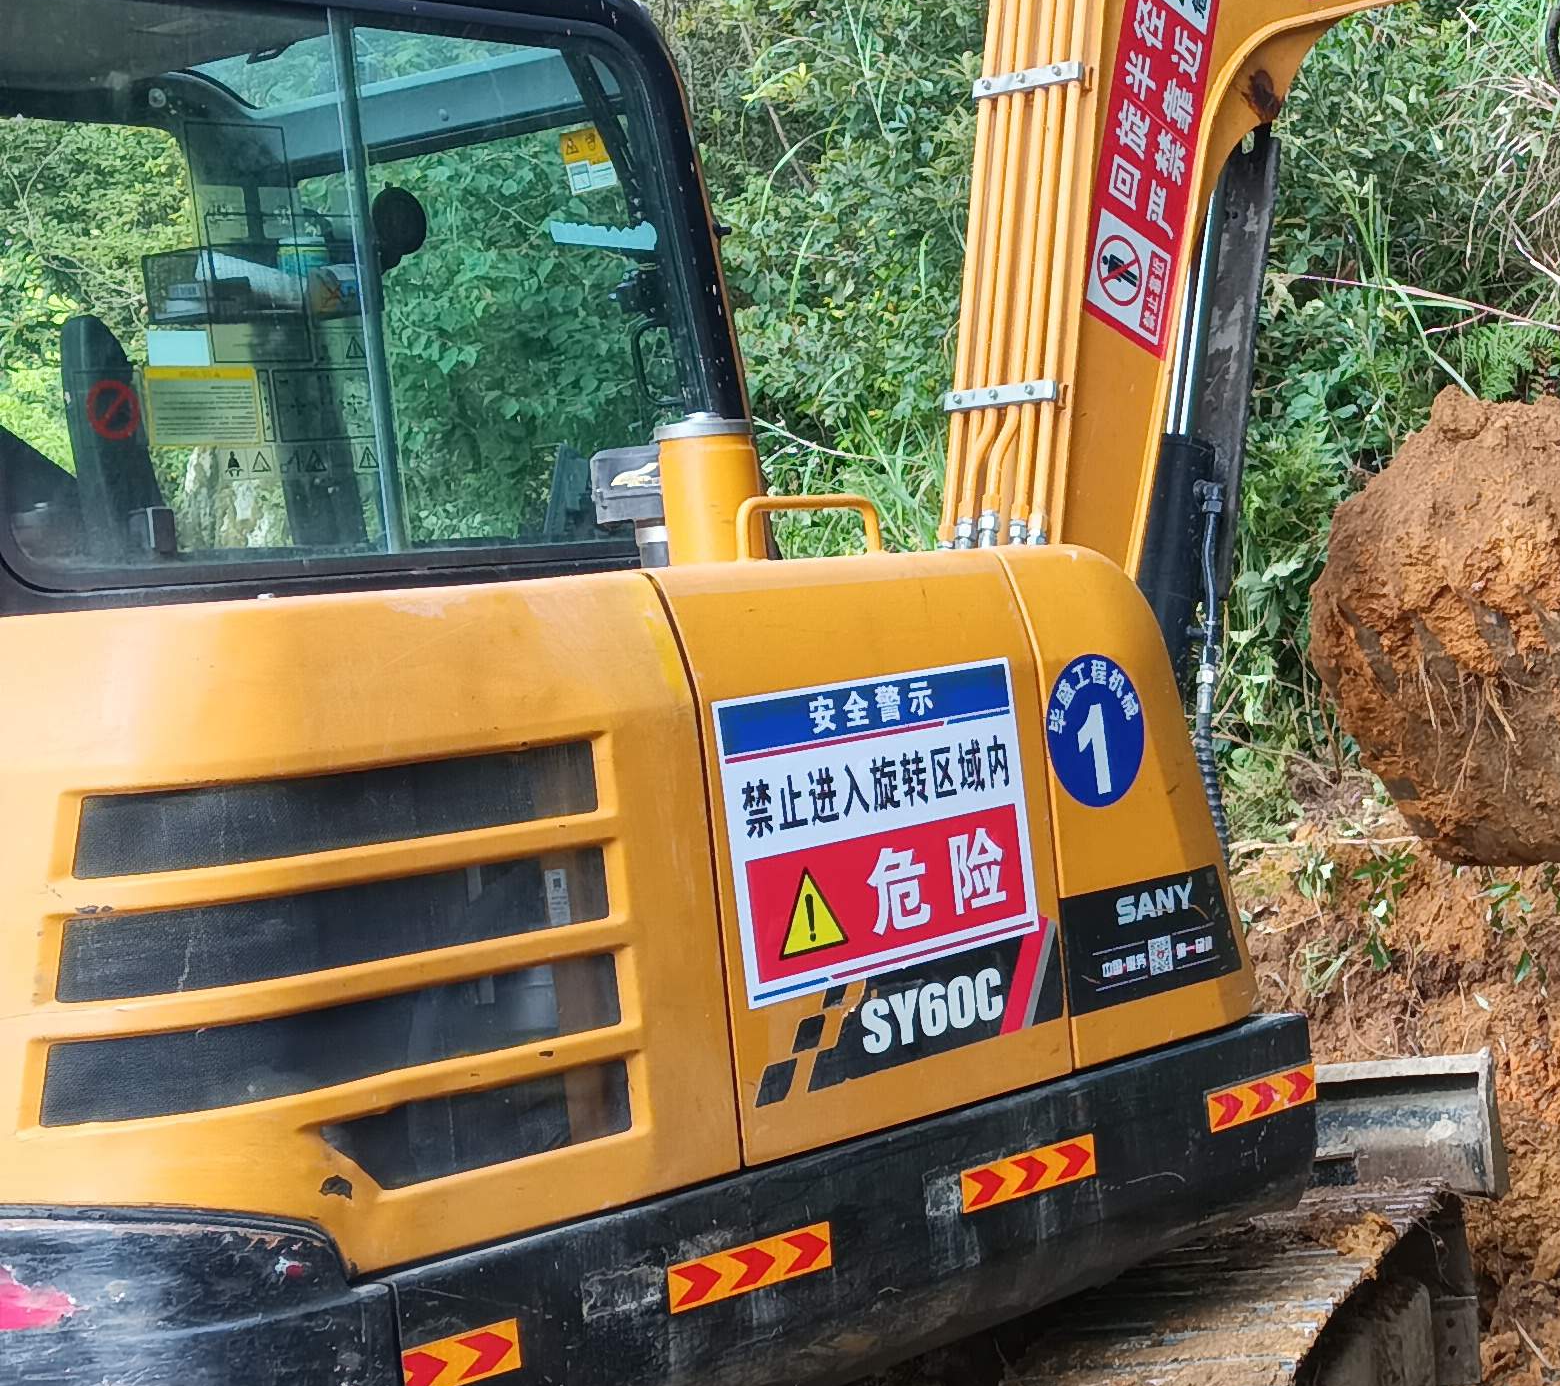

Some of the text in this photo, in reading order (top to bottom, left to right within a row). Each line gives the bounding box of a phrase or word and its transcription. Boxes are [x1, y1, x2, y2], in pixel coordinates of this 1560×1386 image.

[1145, 25, 1204, 240] 严禁靠近
[808, 681, 934, 734] 安全警示
[1077, 703, 1112, 794] 1
[742, 735, 1009, 839] 禁止进入旋转区域内
[867, 828, 1007, 936] 危险
[1116, 880, 1193, 925] SANY
[861, 968, 1003, 1054] SY60C
